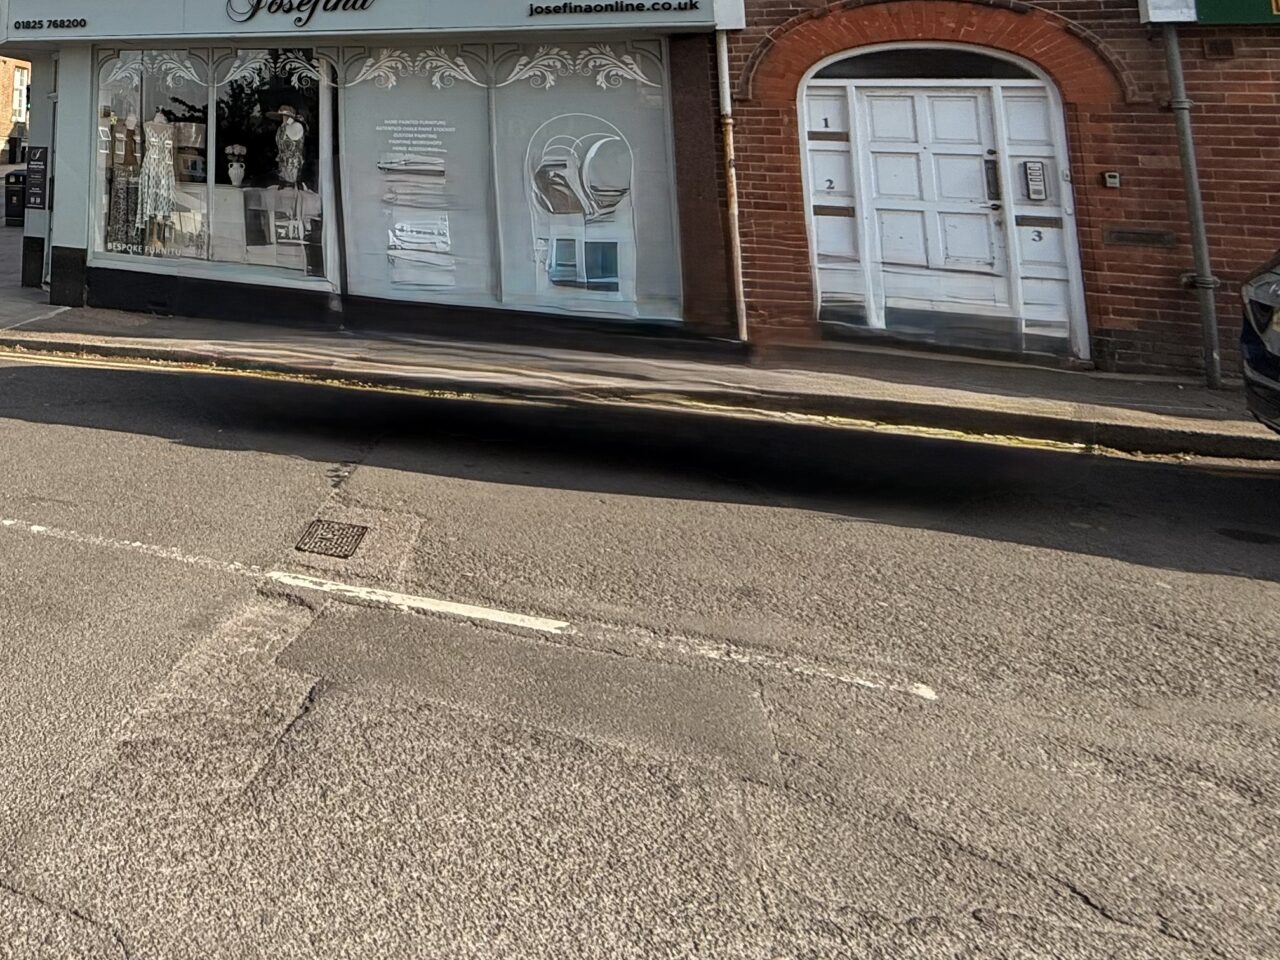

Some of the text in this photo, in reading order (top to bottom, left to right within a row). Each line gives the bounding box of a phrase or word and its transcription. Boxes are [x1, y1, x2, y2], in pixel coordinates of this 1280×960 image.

[14, 18, 87, 30] 01825 768200
[822, 117, 830, 128] 1
[825, 179, 835, 189] 2
[1032, 230, 1042, 242] 3
[107, 242, 142, 253] BESPOKE
